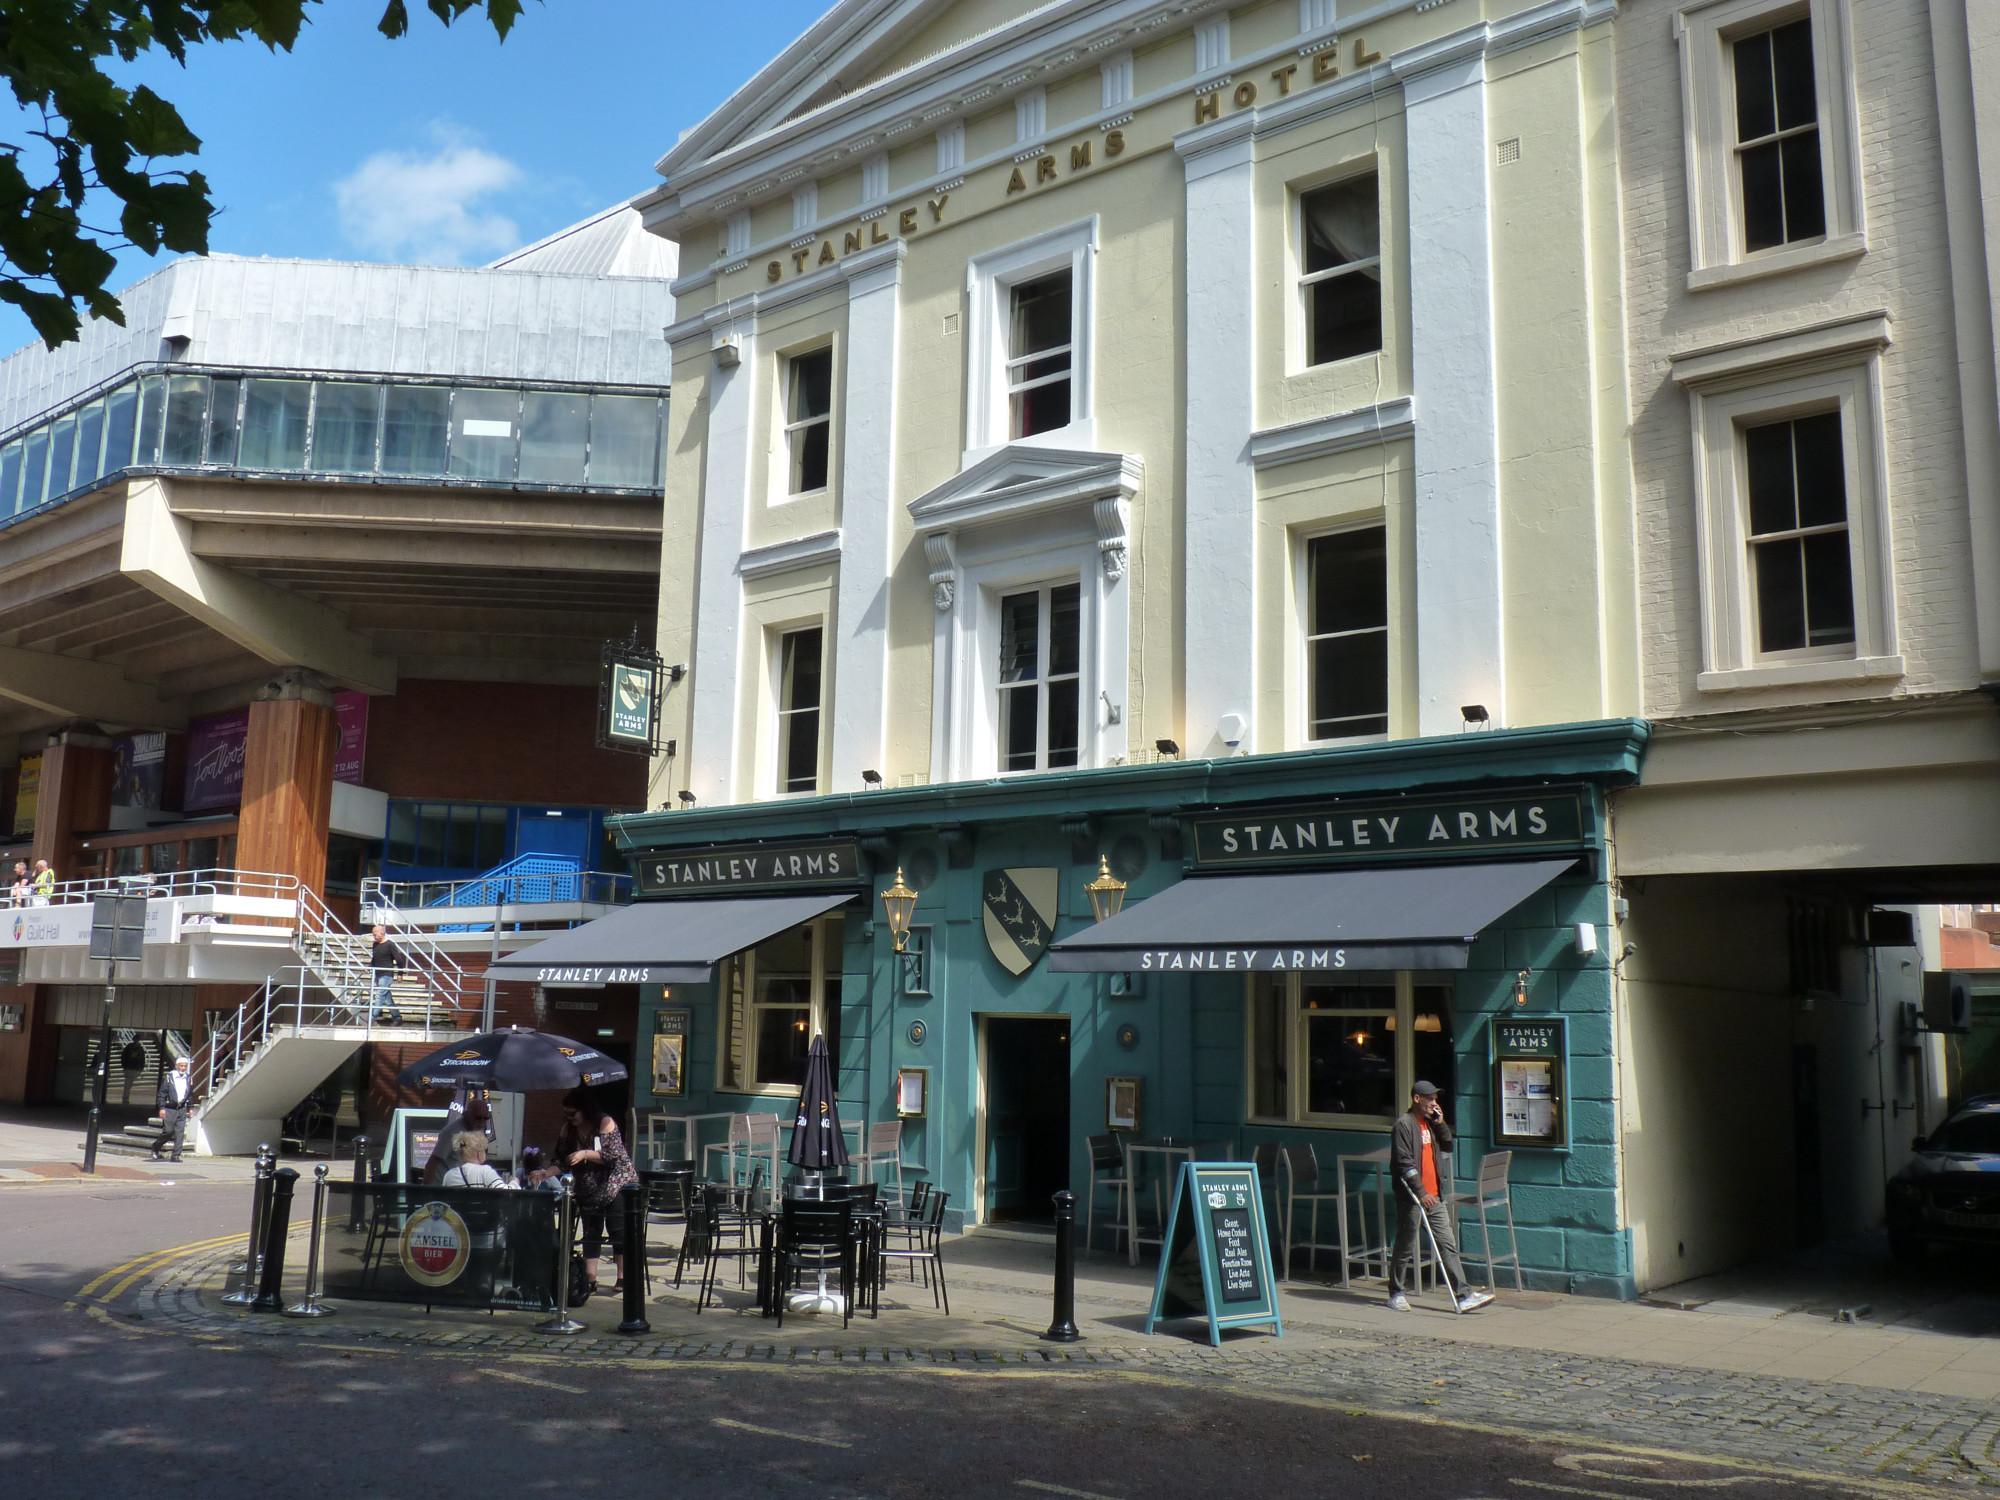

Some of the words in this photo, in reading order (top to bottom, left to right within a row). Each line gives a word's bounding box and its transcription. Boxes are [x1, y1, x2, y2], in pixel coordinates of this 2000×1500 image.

[767, 194, 949, 283] STANLEY
[1006, 130, 1126, 195] ARMS
[1194, 37, 1382, 125] HOTEL
[615, 712, 646, 723] STANLEY
[618, 720, 642, 730] ARMS
[1222, 816, 1400, 852] STANLEY
[1428, 806, 1548, 841] ARMS
[655, 857, 758, 884] STANLEY
[773, 852, 840, 877] ARMS
[1141, 951, 1257, 969] STANLEY
[1272, 949, 1346, 968] ARMS
[537, 968, 603, 981] STANLEY
[608, 968, 648, 982] ARMS
[1503, 1028, 1553, 1037] STANLEY
[1509, 1038, 1548, 1047] ARMS
[1202, 1184, 1229, 1192] STANLEY
[414, 1235, 454, 1248] AMSTEL
[424, 1250, 443, 1258] BIER
